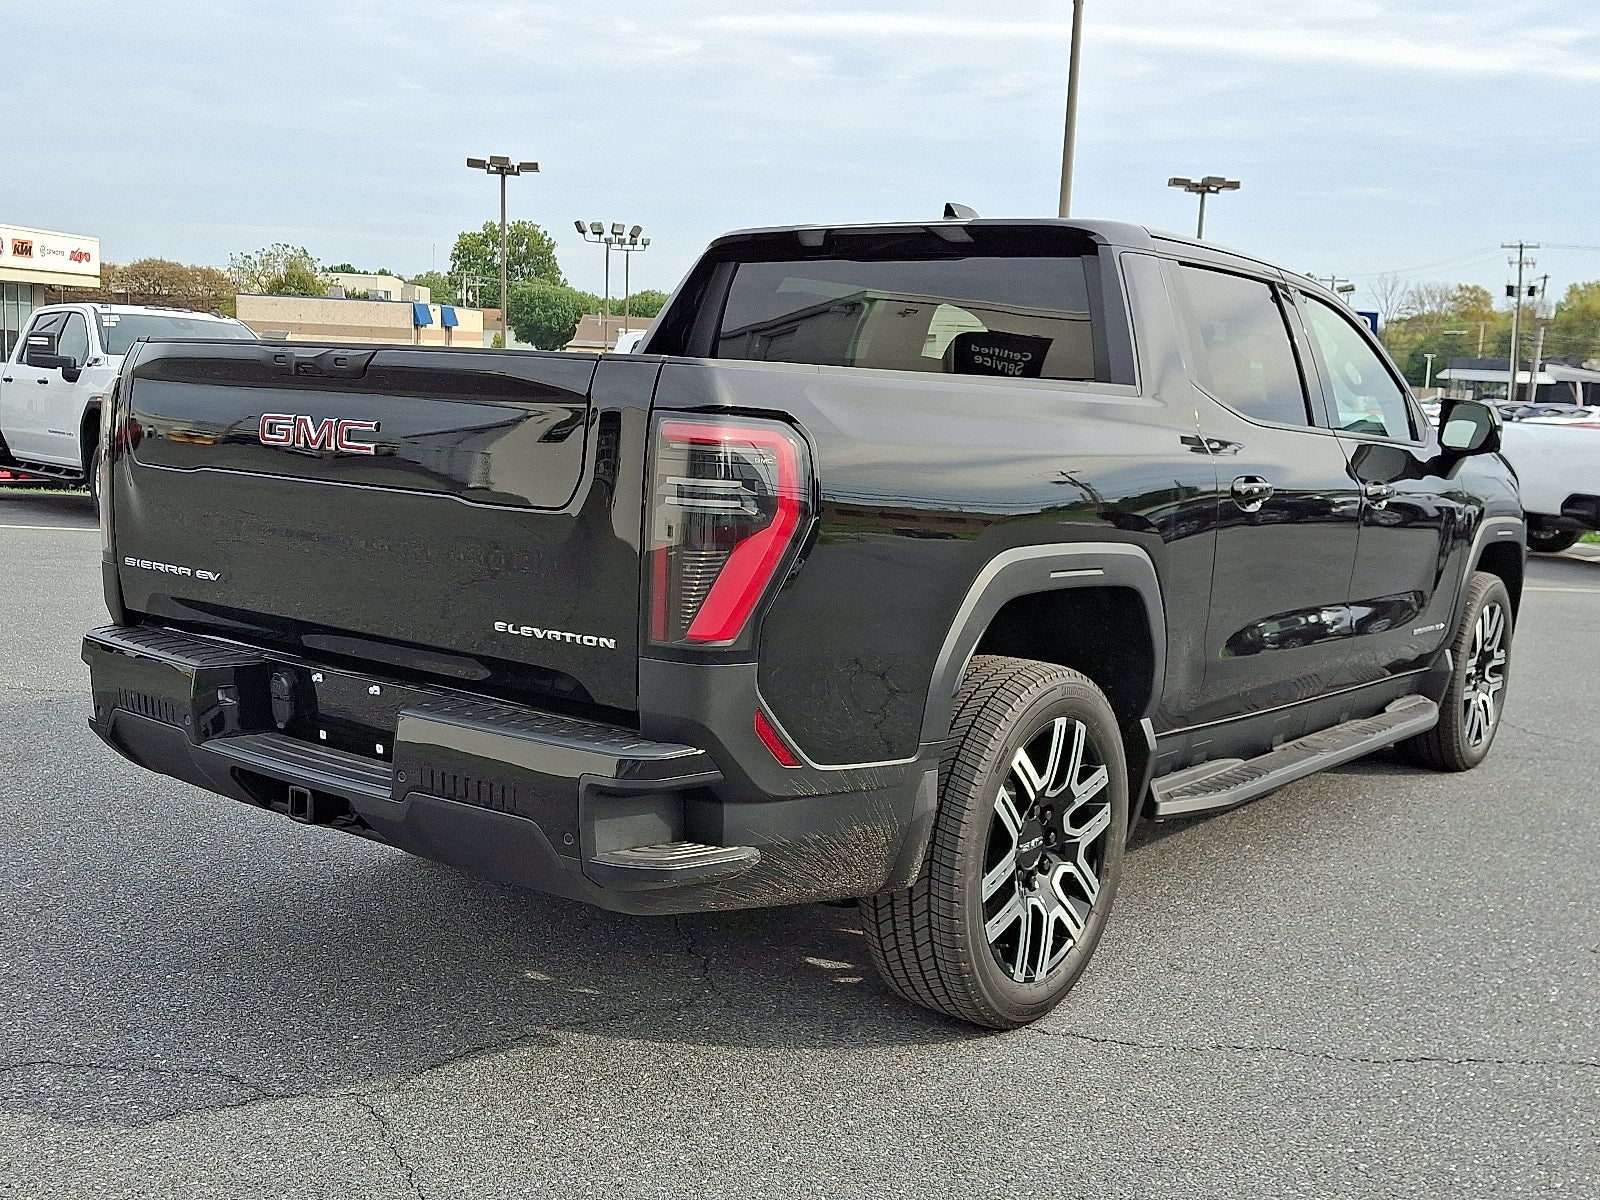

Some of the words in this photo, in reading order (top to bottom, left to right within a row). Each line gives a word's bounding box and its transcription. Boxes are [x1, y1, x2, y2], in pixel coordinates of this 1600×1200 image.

[13, 241, 32, 256] KTM
[260, 413, 380, 455] GMC
[124, 556, 192, 577] SIERRA
[195, 569, 221, 581] EV
[494, 621, 616, 649] ELEVATION
